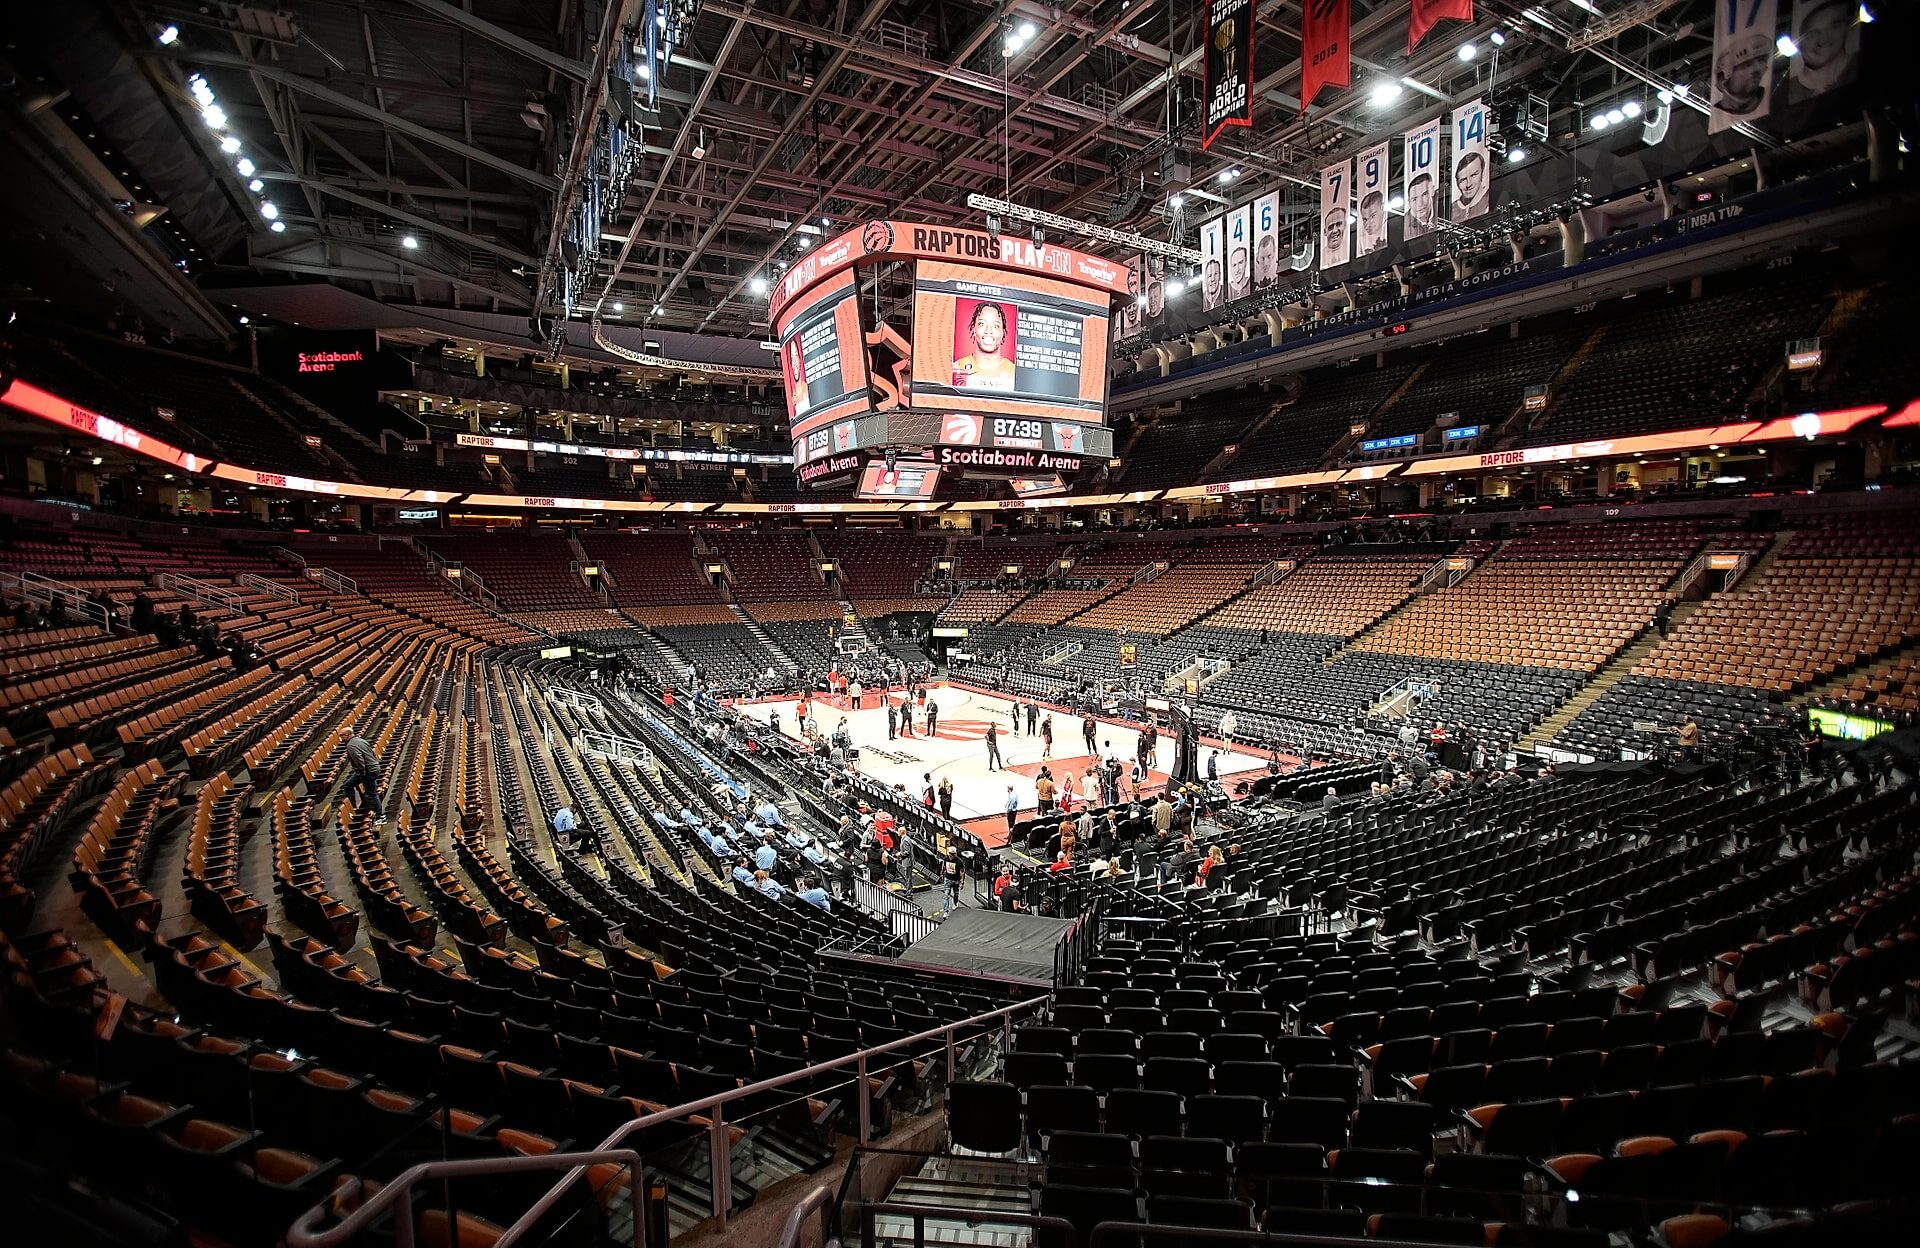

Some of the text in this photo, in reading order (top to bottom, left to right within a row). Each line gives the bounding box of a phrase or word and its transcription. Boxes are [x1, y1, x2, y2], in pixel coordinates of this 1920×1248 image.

[1312, 43, 1338, 66] 2019
[1216, 75, 1238, 97] 2019
[1209, 83, 1246, 116] WORLD
[1458, 111, 1484, 151] 14
[1411, 136, 1433, 173] 10
[1366, 158, 1379, 189] 9
[1329, 174, 1342, 204] 7
[1261, 206, 1272, 232] 6
[1690, 211, 1716, 229] NBA
[1718, 205, 1735, 220] TV
[1234, 218, 1244, 243] 4
[914, 228, 1001, 261] RAPTORS
[1209, 232, 1214, 255] 1
[1302, 261, 1530, 332] THE FOSTER HEWITT MEDIA GONDOLA
[124, 332, 146, 345] 324
[298, 350, 363, 363] Scotiabank
[298, 363, 335, 372] Arena
[994, 418, 1042, 438] 87:39
[403, 443, 418, 452] 301
[462, 436, 494, 446] RAPTORS
[808, 429, 828, 451] 87:39
[563, 456, 578, 465] 302
[700, 464, 727, 472] STREET
[830, 456, 858, 472] Arena
[941, 448, 1081, 470] Scotiabank Arena
[1480, 452, 1524, 466] RAPTORS
[256, 473, 286, 486] RAPTORS
[1206, 484, 1230, 493] RAPTORS
[524, 498, 556, 506] RAPTORS
